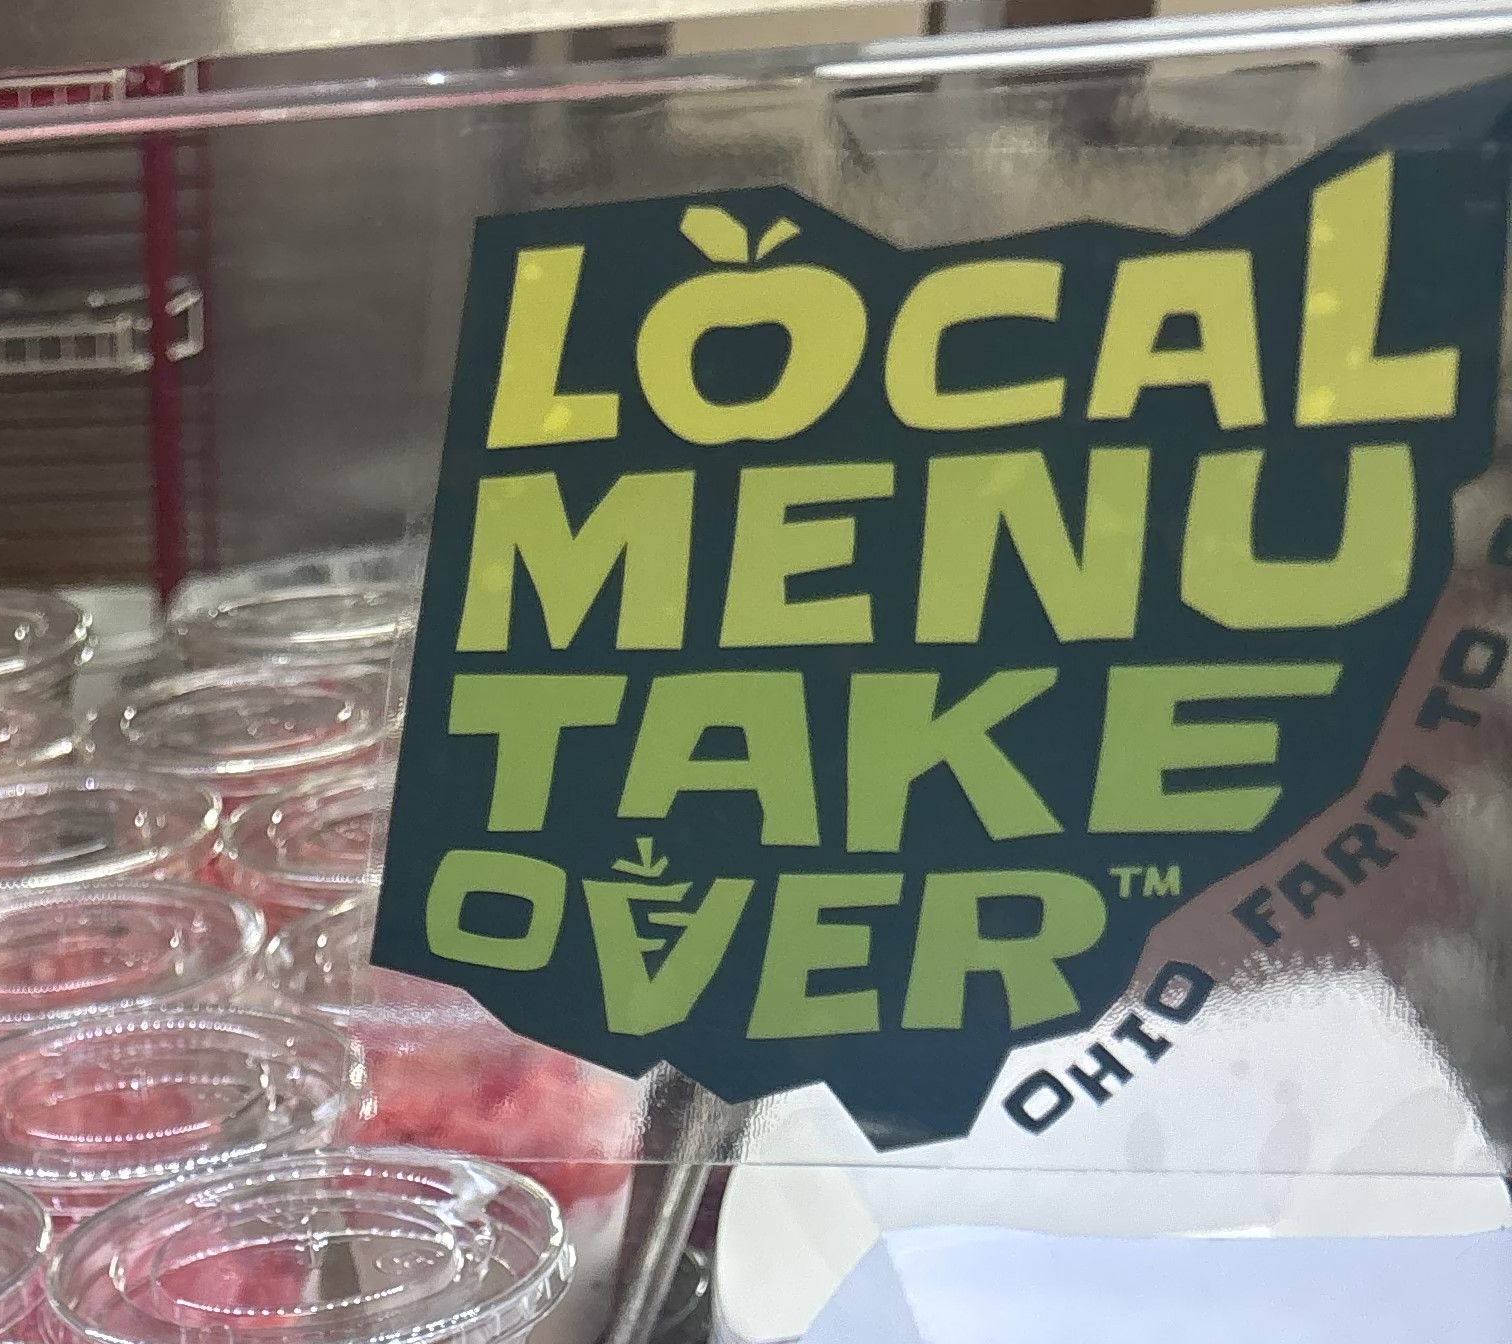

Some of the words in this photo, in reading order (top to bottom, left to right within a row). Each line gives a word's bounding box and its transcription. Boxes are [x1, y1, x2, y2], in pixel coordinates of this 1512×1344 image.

[487, 153, 1460, 450] LOCAL
[454, 441, 1418, 653] MENU
[447, 661, 1346, 855] TAKE
[1001, 959, 1219, 1139] OHIO
[1230, 762, 1452, 950] FARM
[1414, 625, 1510, 731] TO
